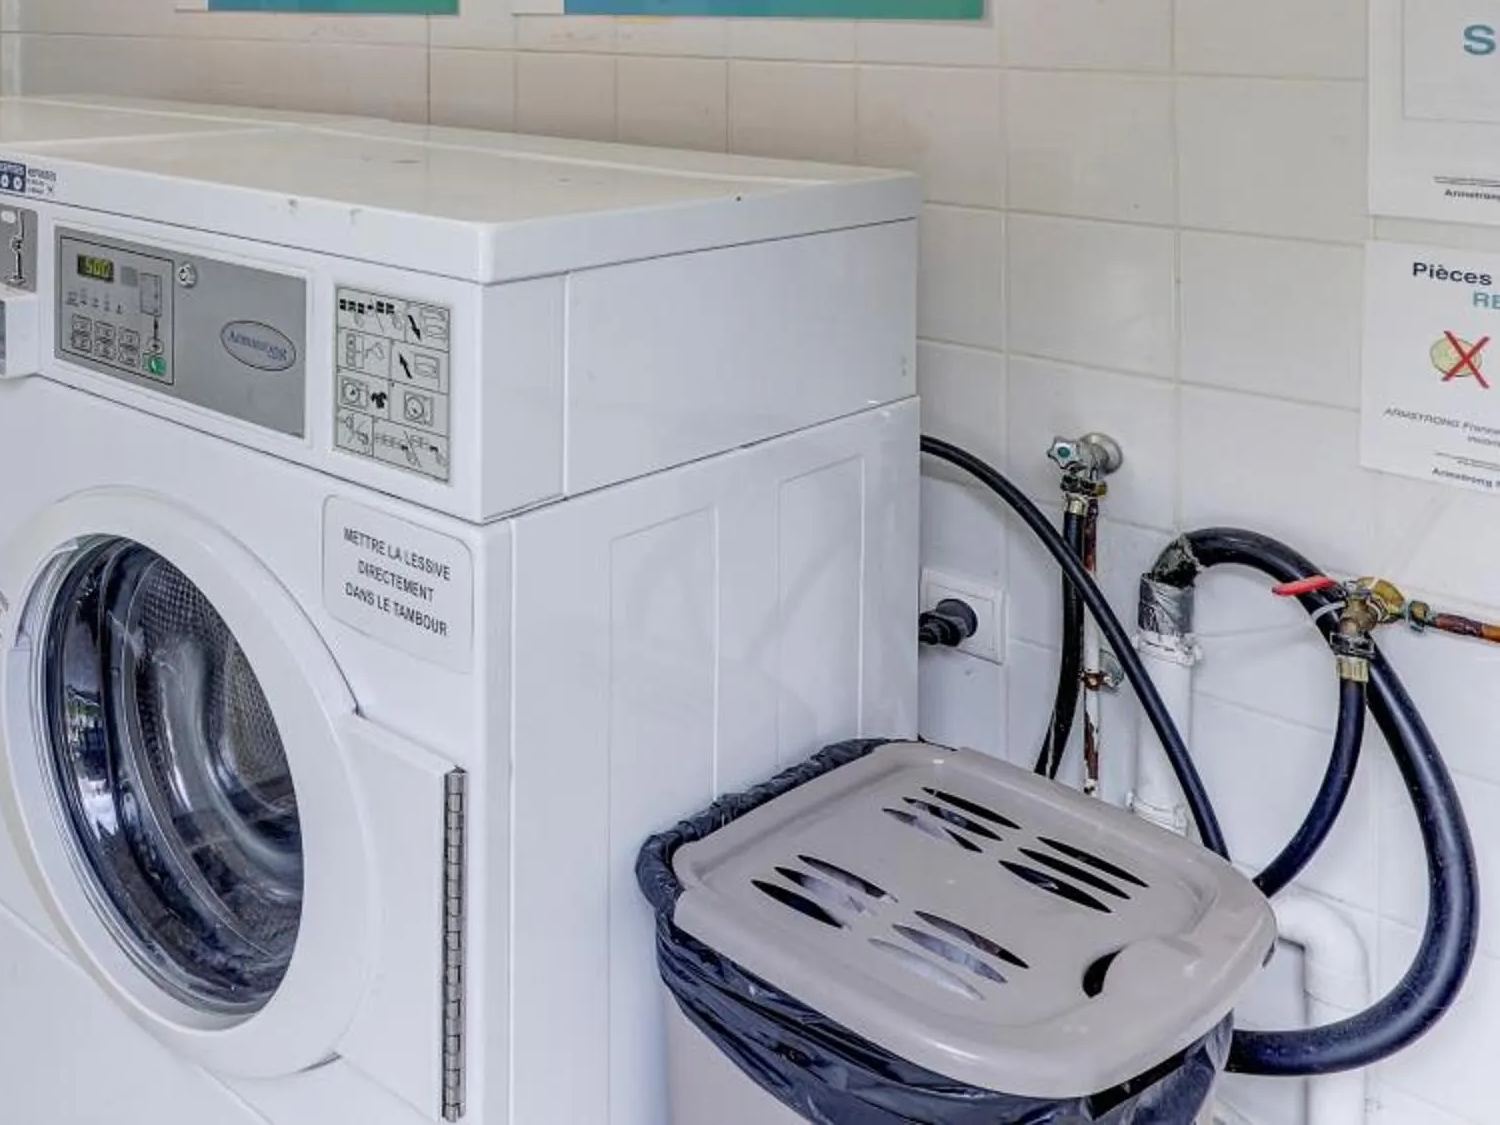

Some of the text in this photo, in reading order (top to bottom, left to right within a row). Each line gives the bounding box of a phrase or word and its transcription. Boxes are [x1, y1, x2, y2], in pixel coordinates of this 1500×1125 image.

[1464, 25, 1496, 55] S
[1413, 261, 1492, 286] Pièces
[344, 527, 450, 581] METTRE LA LESSIVE
[358, 560, 434, 602] DIRECTEMENT
[345, 582, 447, 635] DANS LE TAMBOUR
